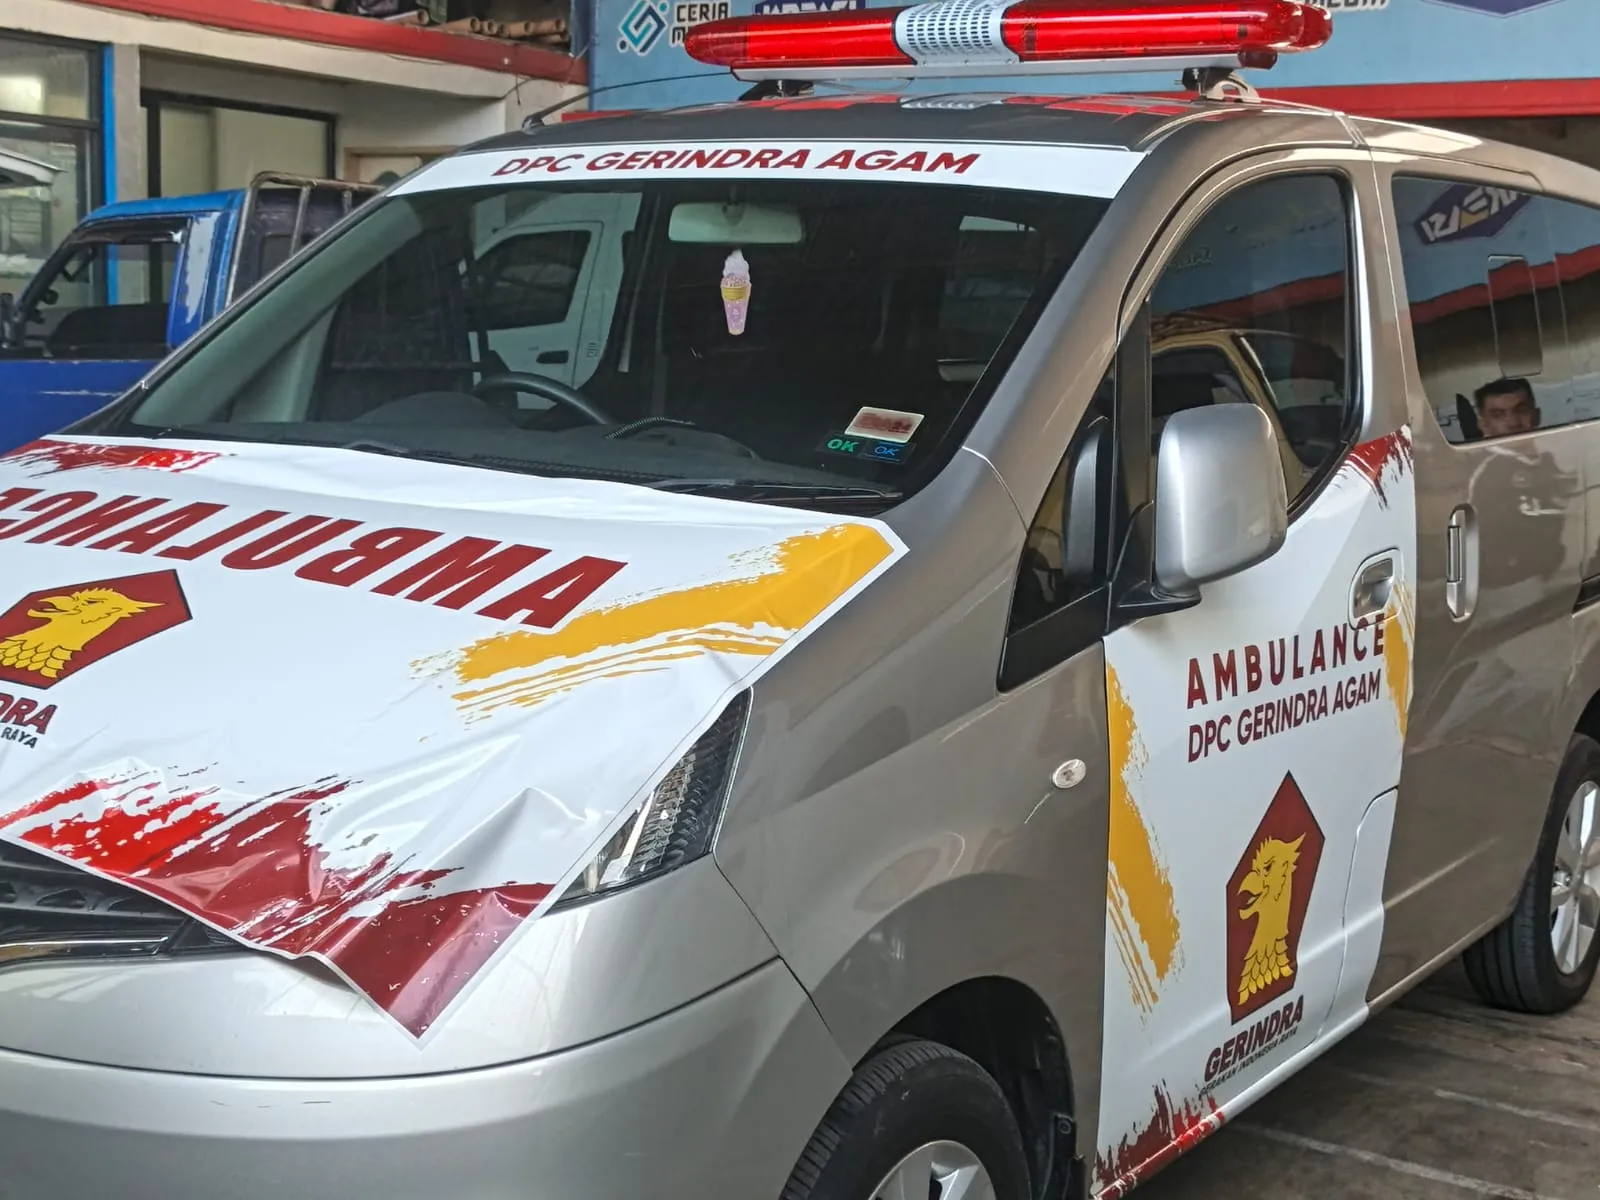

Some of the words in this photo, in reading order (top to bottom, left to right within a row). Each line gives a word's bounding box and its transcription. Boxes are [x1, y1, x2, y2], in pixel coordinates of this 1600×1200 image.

[676, 2, 729, 22] CERIA
[491, 154, 585, 176] DPC
[586, 149, 811, 171] GERINDRA
[815, 149, 981, 175] AGAM
[827, 438, 859, 453] OK
[874, 445, 900, 456] OK
[1187, 612, 1385, 710] AMBULANCE
[1187, 714, 1232, 763] DPC
[1237, 685, 1328, 746] GERINDRA
[1332, 668, 1382, 715] AGAM
[1, 727, 39, 749] RAYA
[1204, 994, 1304, 1083] GERINDRA
